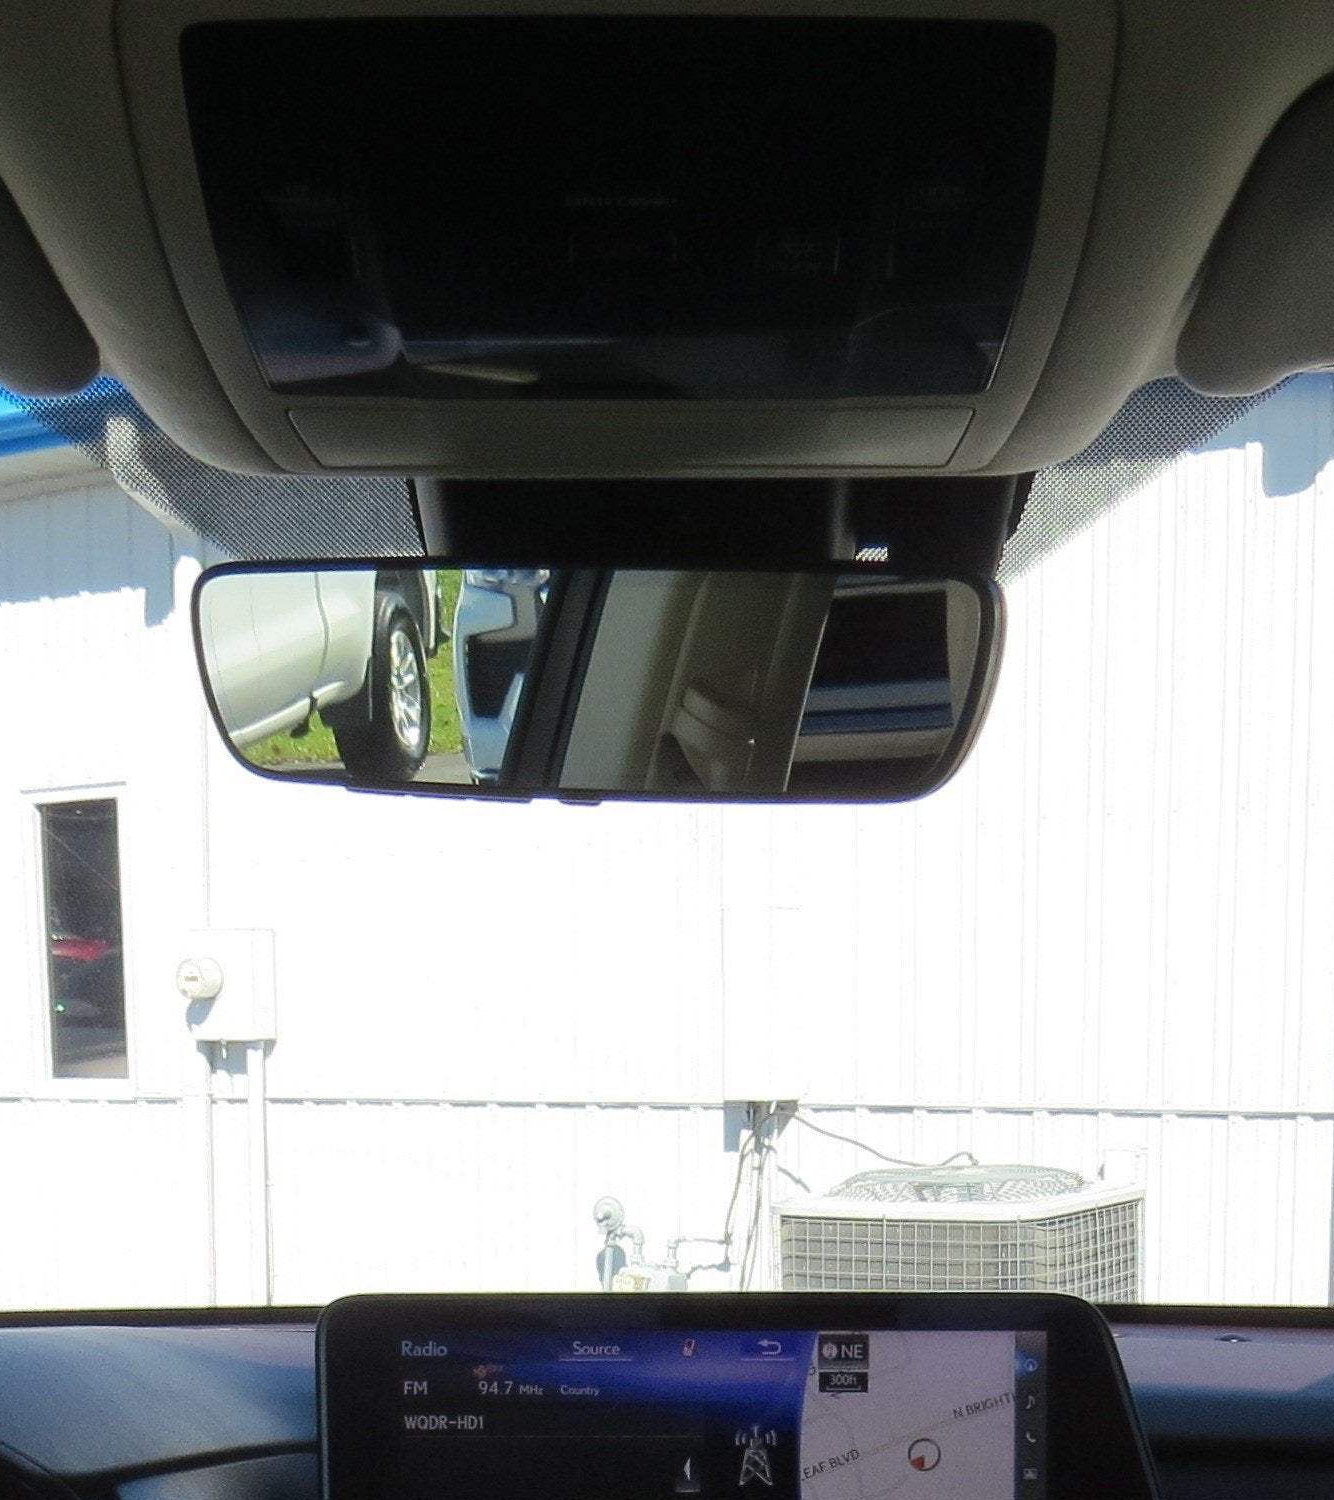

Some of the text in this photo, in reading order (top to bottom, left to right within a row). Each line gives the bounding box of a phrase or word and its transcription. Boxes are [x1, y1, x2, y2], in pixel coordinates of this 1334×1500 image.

[401, 1341, 448, 1357] Radio
[573, 1341, 621, 1356] Source
[840, 1344, 864, 1359] NE
[829, 1374, 858, 1386] 300ft
[403, 1381, 600, 1397] FM 94.7 MHz Country
[952, 1407, 963, 1419] N
[404, 1415, 484, 1430] WQDR-HD1
[830, 1449, 860, 1469] BLVD
